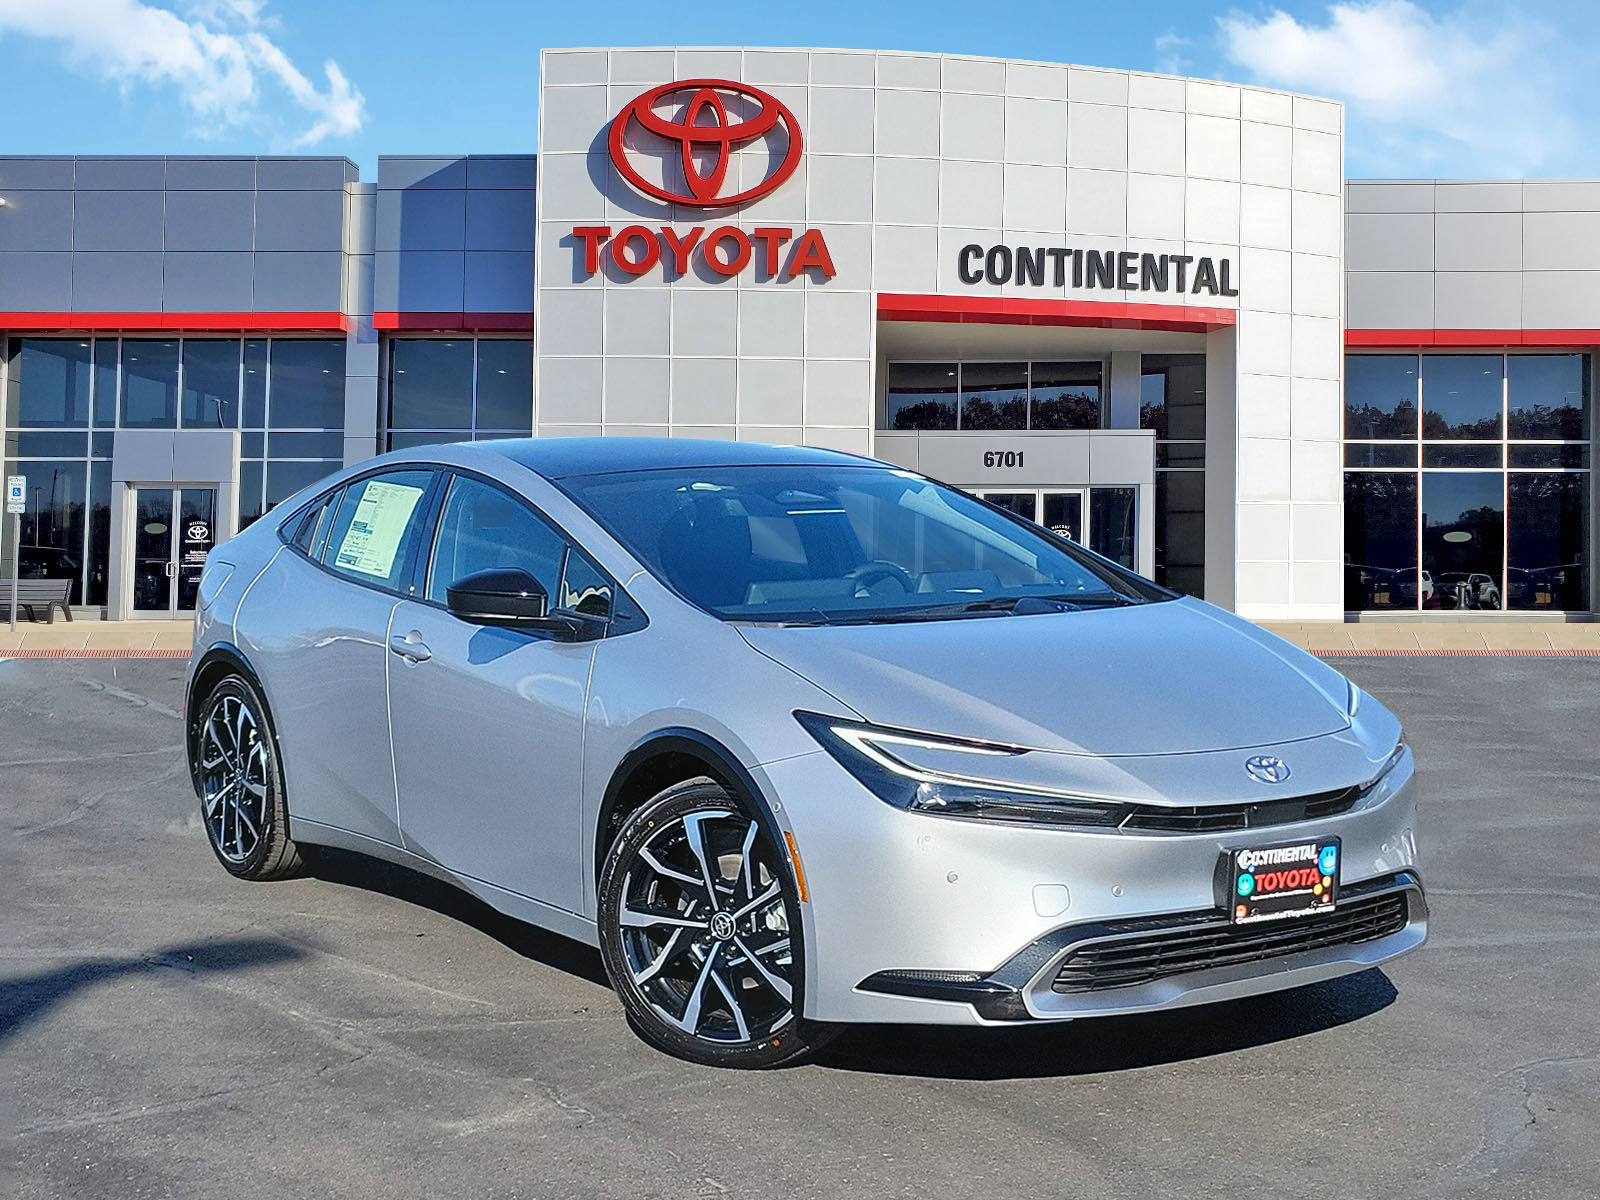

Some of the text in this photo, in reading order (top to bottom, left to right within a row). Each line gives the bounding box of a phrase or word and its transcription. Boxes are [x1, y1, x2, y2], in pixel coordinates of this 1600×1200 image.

[572, 225, 837, 277] TOYOTA
[958, 244, 1239, 297] CONTINENTAL
[983, 451, 1024, 468] 6701
[1237, 844, 1318, 870] CONTINENTAL
[1254, 867, 1320, 892] TOYOTA
